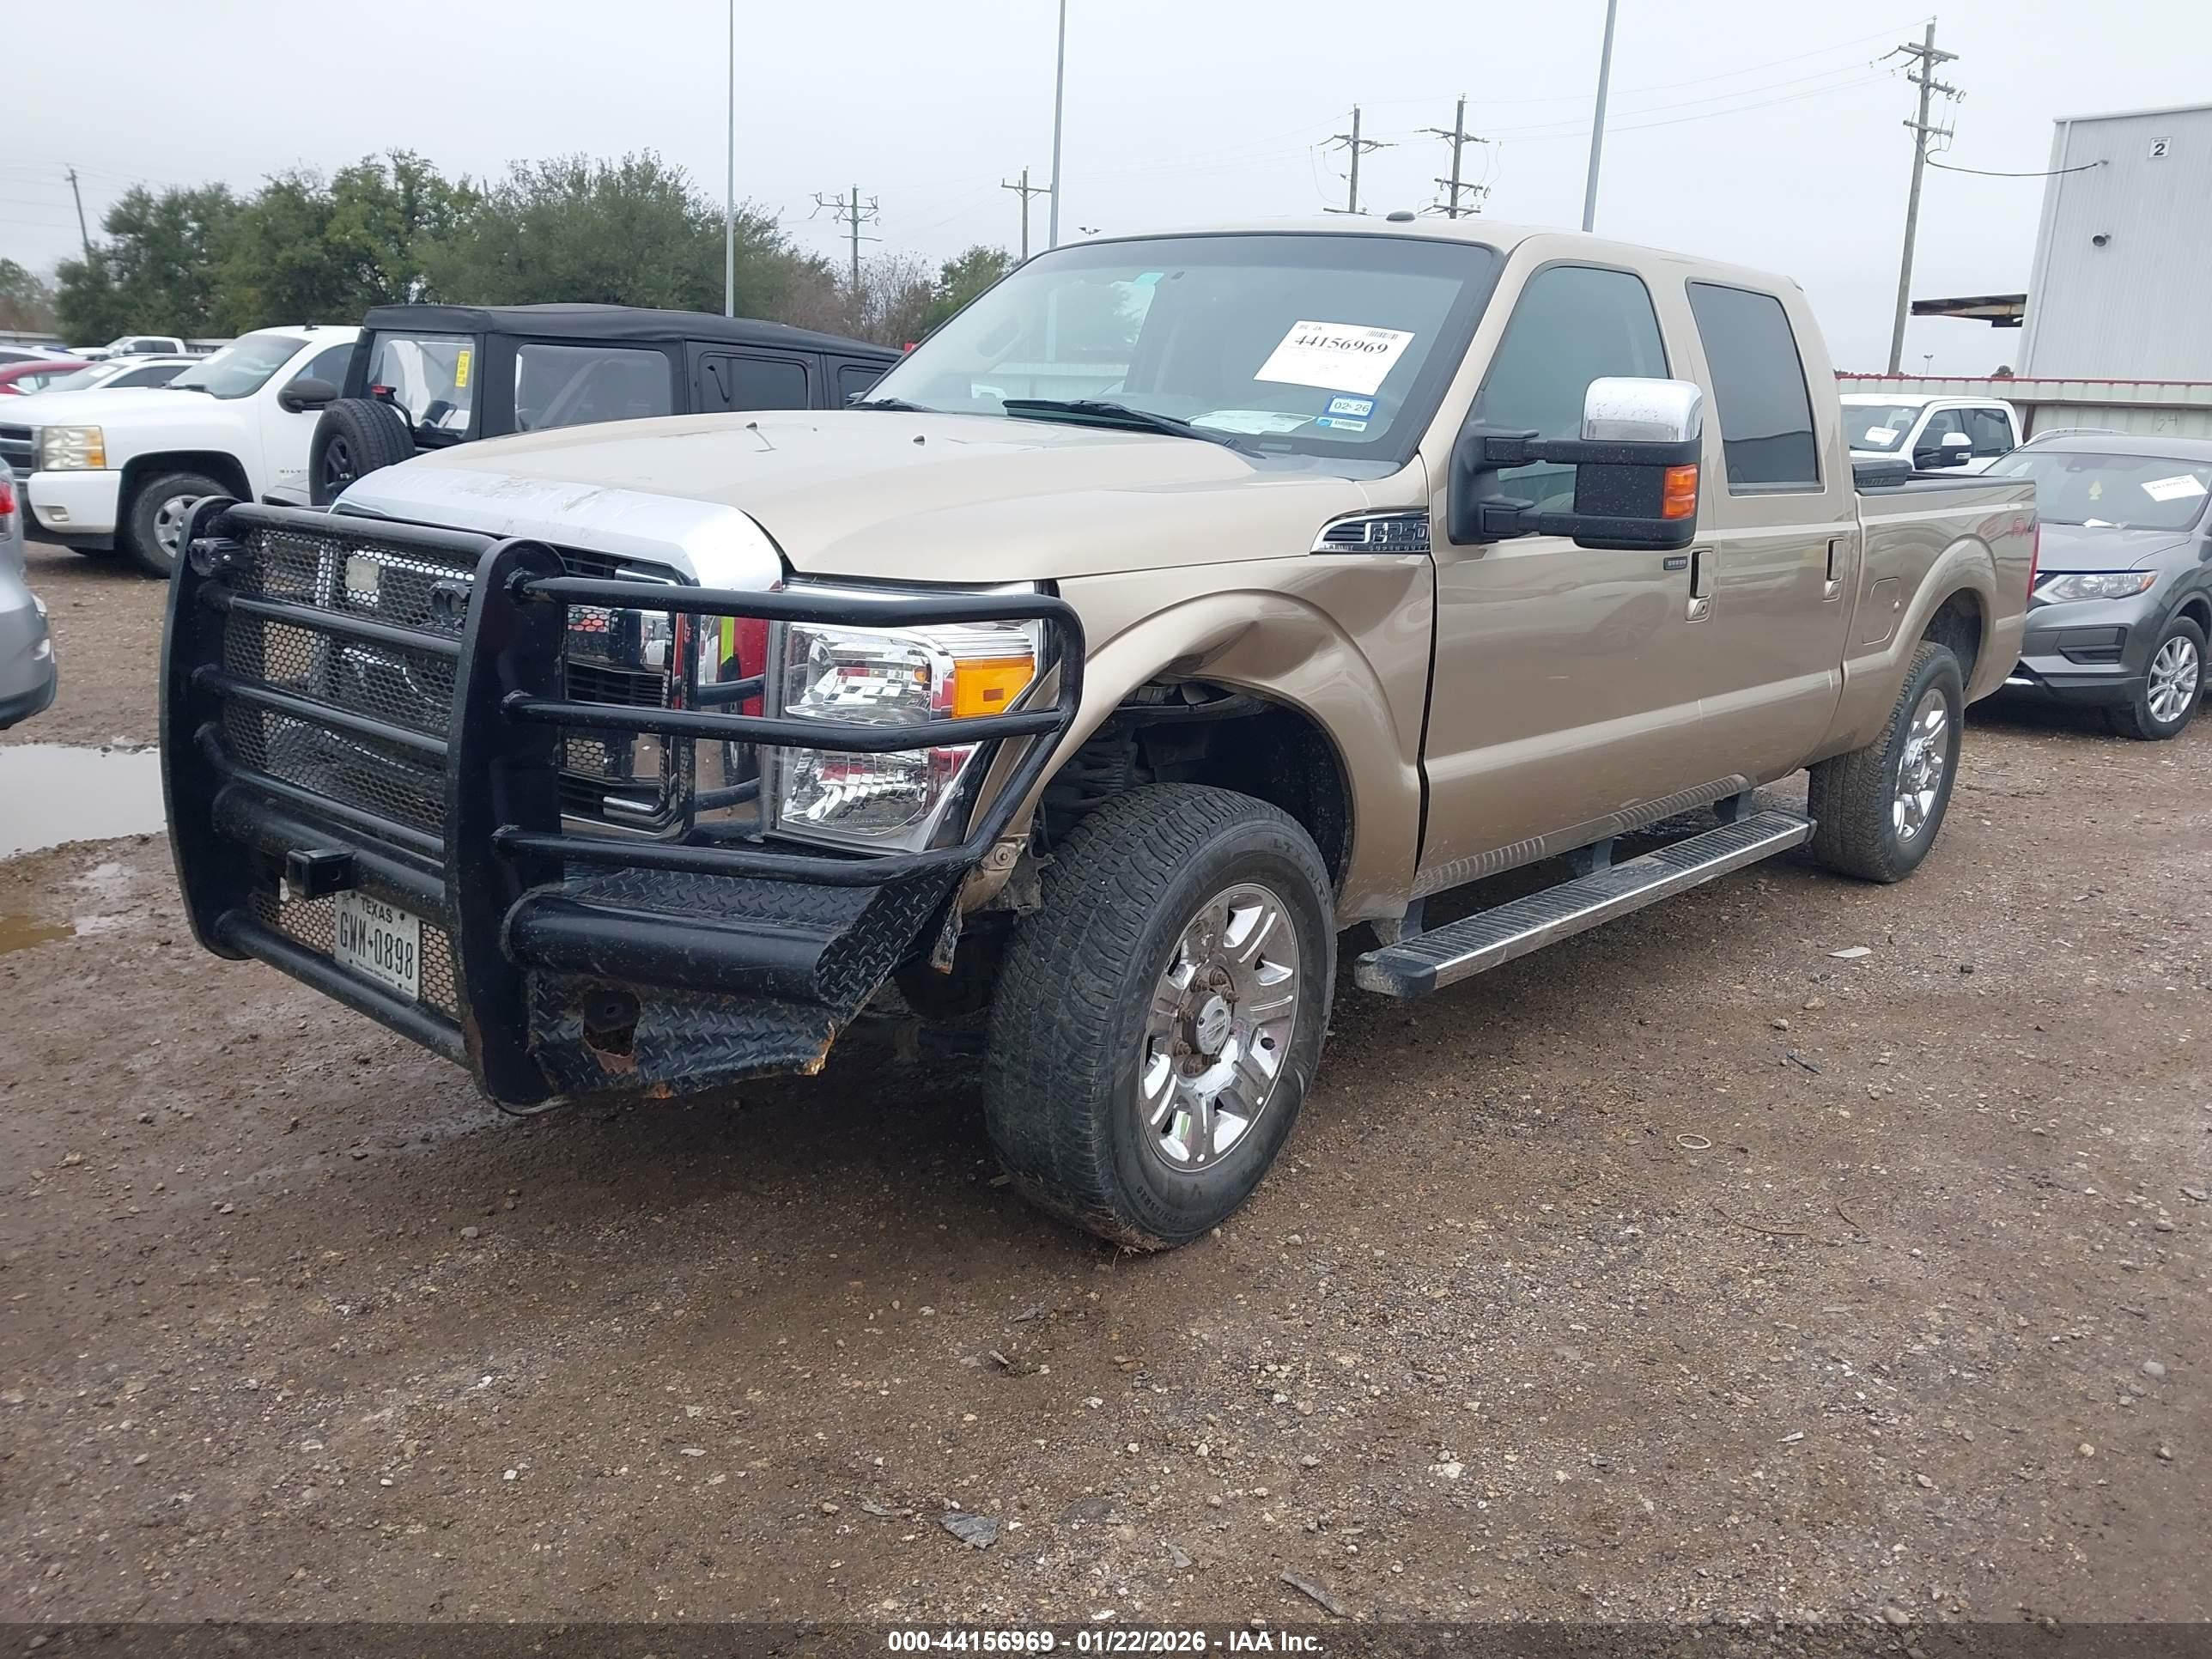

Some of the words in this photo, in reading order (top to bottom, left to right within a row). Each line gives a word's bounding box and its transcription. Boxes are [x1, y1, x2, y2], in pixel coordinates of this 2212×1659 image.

[2154, 143, 2165, 156] 2
[1295, 335, 1389, 354] 44156969
[361, 896, 392, 924] TEXAS
